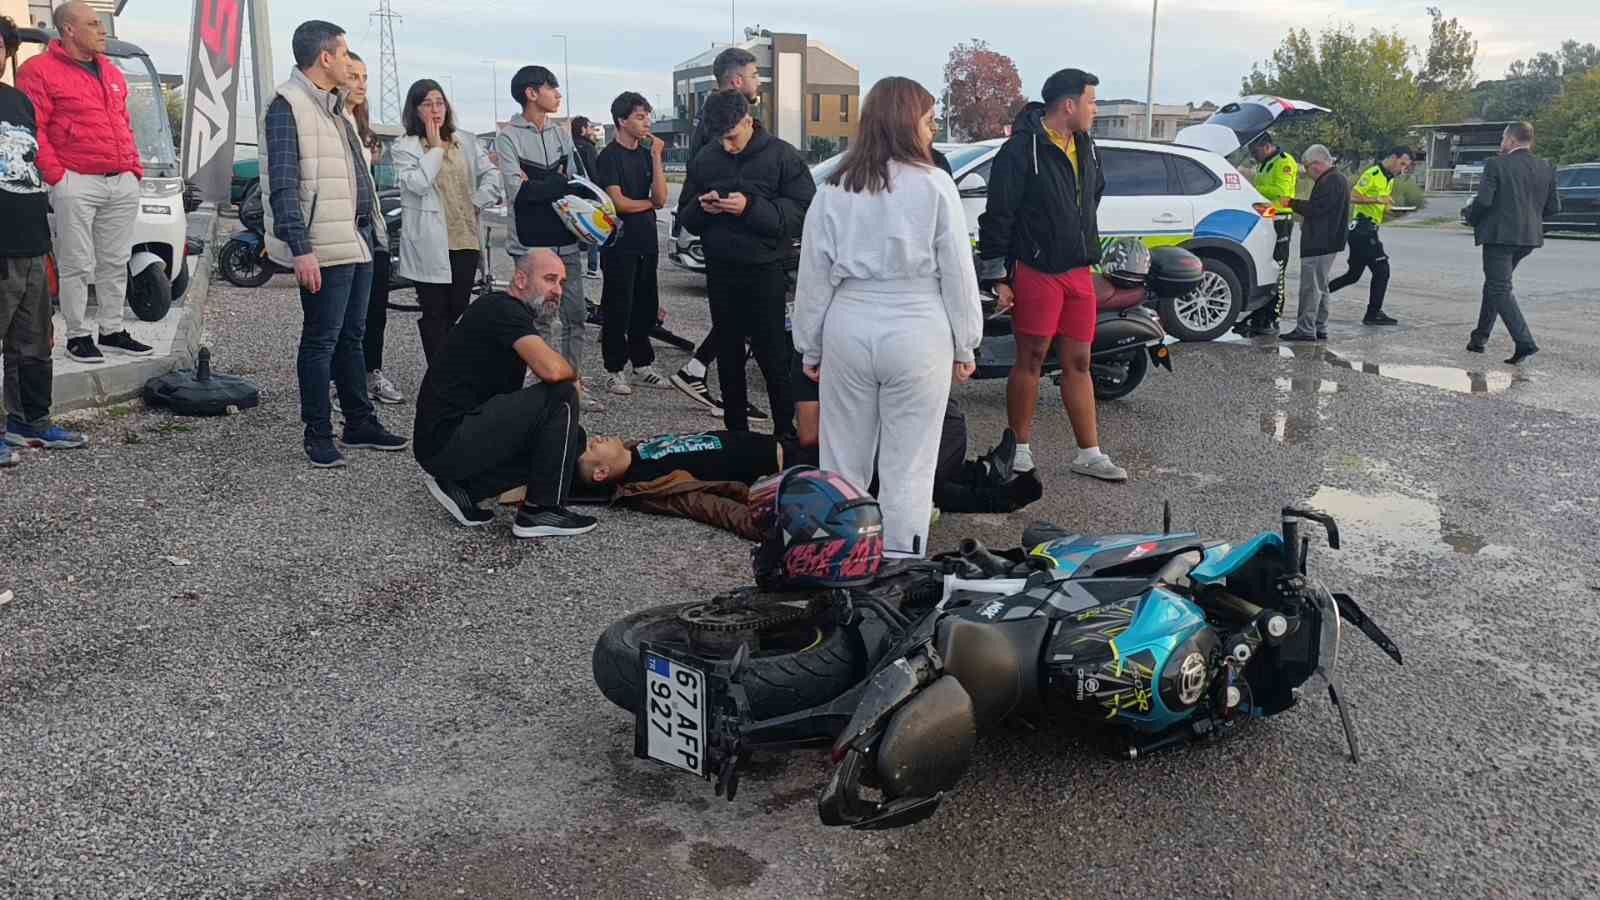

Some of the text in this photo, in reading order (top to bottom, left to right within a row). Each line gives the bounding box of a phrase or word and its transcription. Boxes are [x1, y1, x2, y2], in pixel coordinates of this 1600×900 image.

[648, 655, 656, 671] TR
[651, 680, 672, 738] 927
[676, 670, 698, 770] 67 AFP
